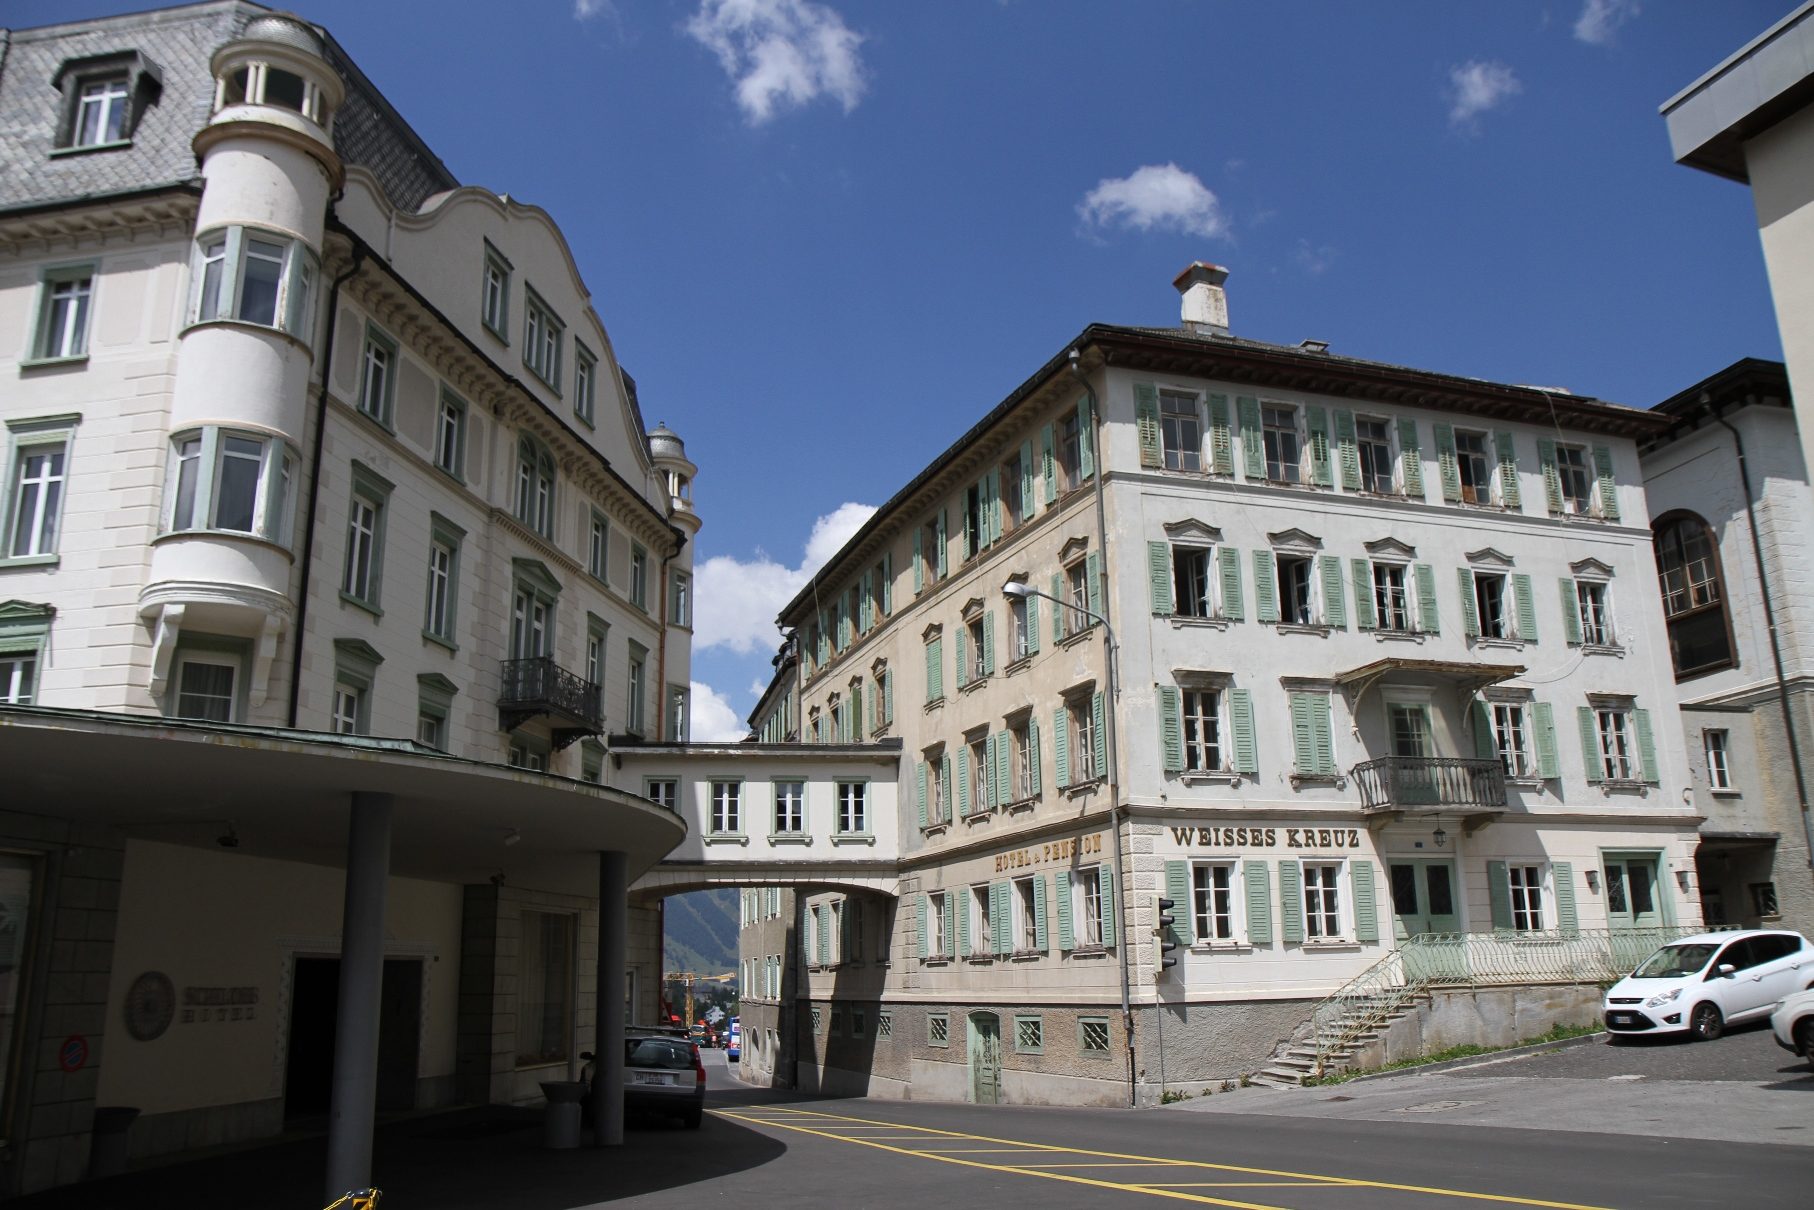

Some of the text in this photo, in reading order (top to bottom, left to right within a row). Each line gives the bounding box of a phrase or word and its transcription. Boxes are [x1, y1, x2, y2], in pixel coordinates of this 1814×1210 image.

[1171, 827, 1360, 848] WEISSES KREUZ
[995, 849, 1031, 872] HOTEL
[1043, 834, 1102, 862] PENSION
[181, 1007, 256, 1024] HOTEL
